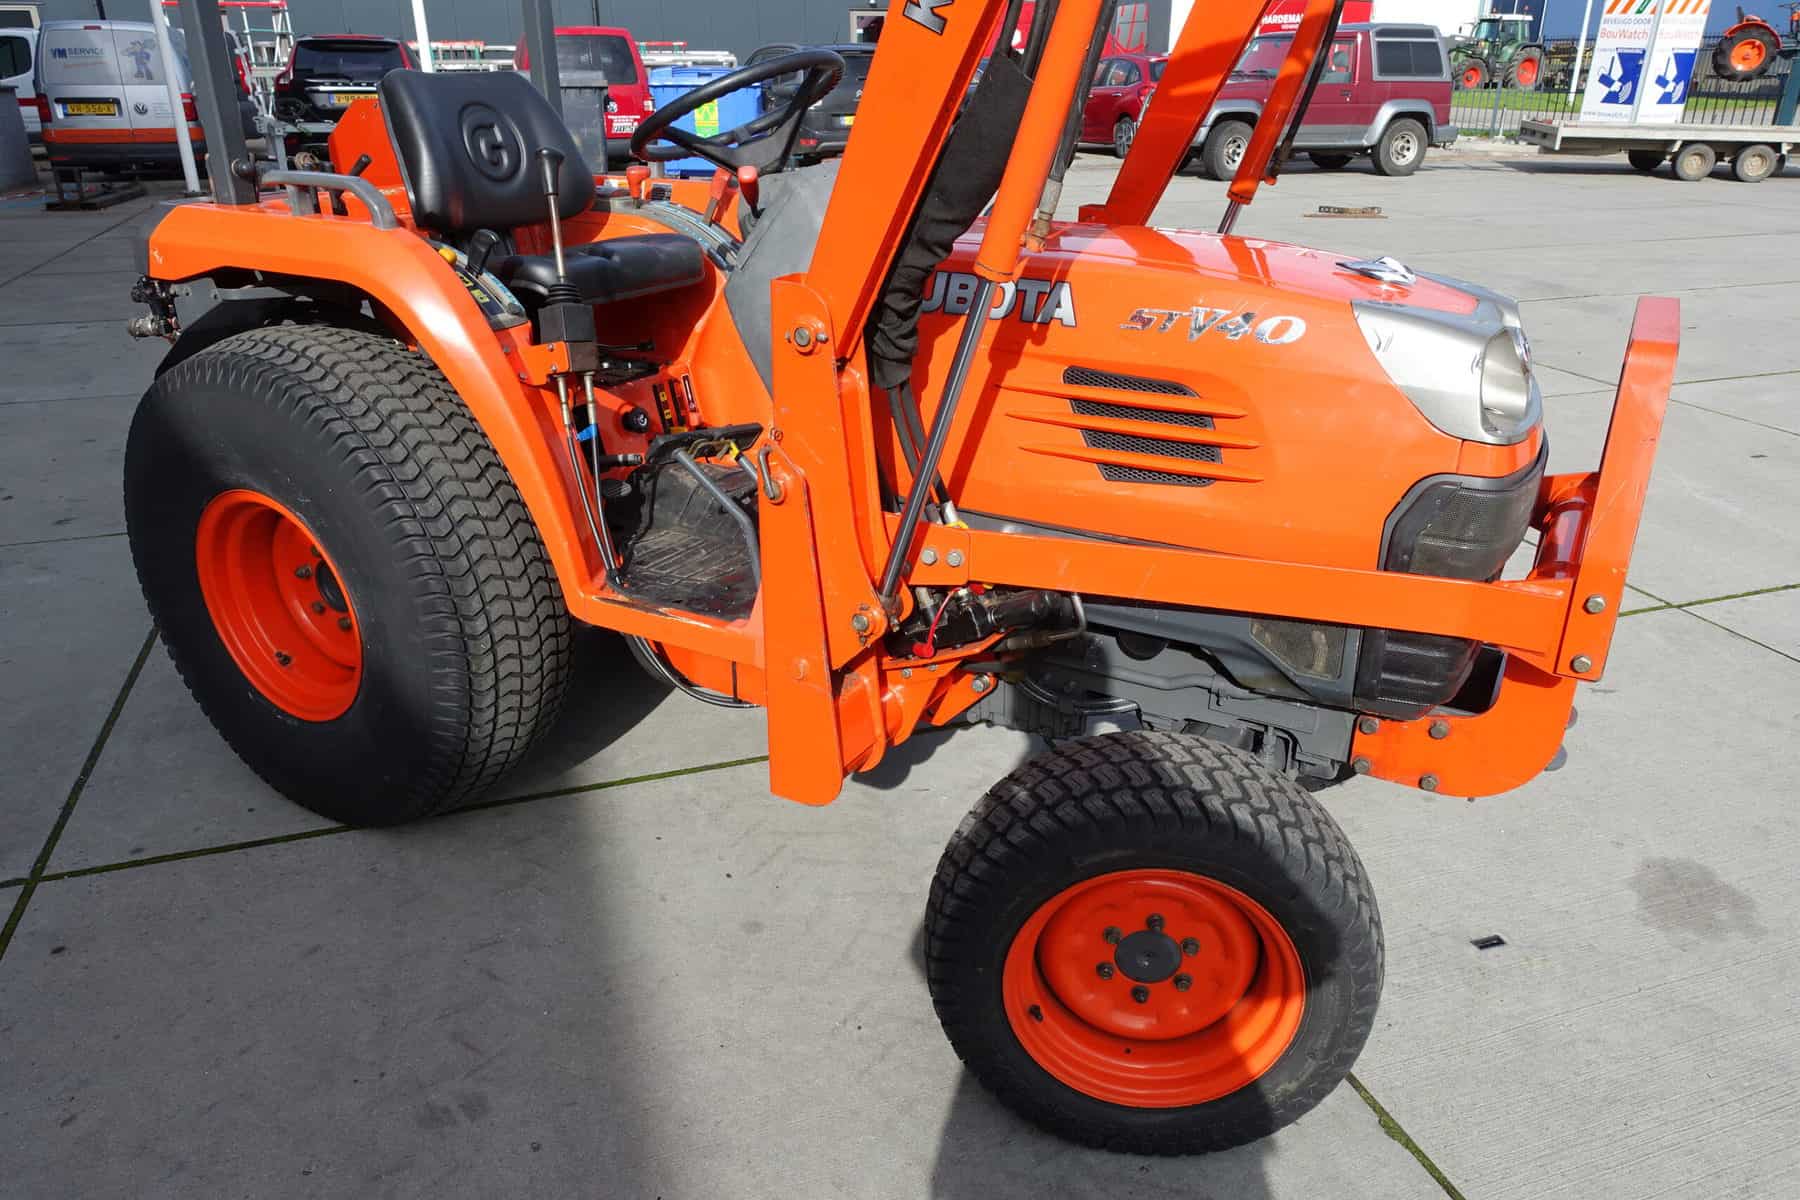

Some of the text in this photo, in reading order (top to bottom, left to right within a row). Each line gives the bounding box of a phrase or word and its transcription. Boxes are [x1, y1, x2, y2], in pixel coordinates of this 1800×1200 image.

[1262, 13, 1304, 24] HARDEMA
[1600, 27, 1649, 40] BouWatch
[920, 270, 1077, 328] UBOTA
